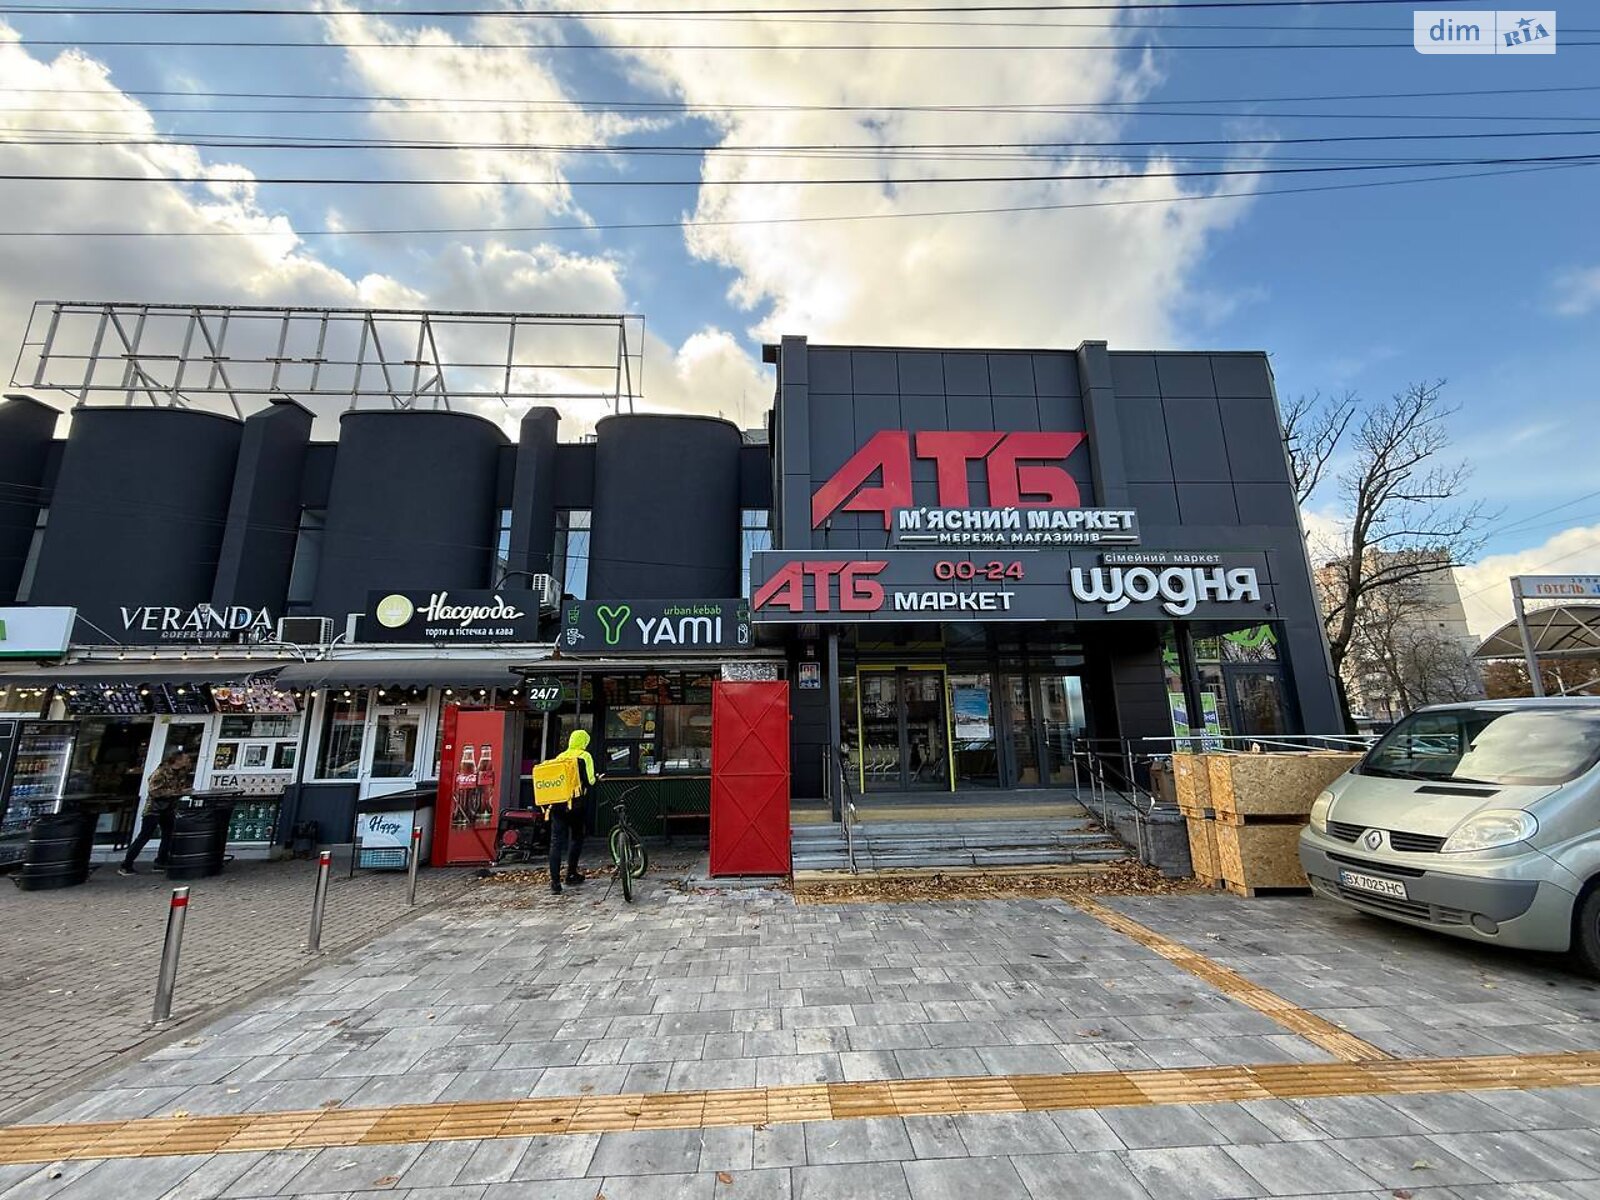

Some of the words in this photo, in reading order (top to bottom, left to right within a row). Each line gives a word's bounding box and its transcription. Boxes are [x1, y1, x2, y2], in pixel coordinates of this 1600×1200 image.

[812, 430, 1087, 530] АТБ
[1028, 510, 1135, 530] МАРКЕТ
[940, 532, 1005, 542] МЕРЕЖА
[1011, 532, 1101, 542] МАГАЗИНІВ
[1104, 552, 1166, 562] сімейний
[1174, 553, 1220, 563] маркет
[934, 561, 1025, 580] 00-24
[754, 561, 888, 612] АТБ
[894, 592, 1015, 611] МАРКЕТ
[1536, 584, 1585, 594] ГОТЕЛЬ
[664, 605, 690, 615] urban
[693, 604, 722, 615] kebab
[120, 605, 272, 631] VERANDA
[425, 628, 448, 638] торти
[495, 628, 514, 636] кава
[530, 688, 559, 700] 24/7
[214, 775, 238, 786] TEA
